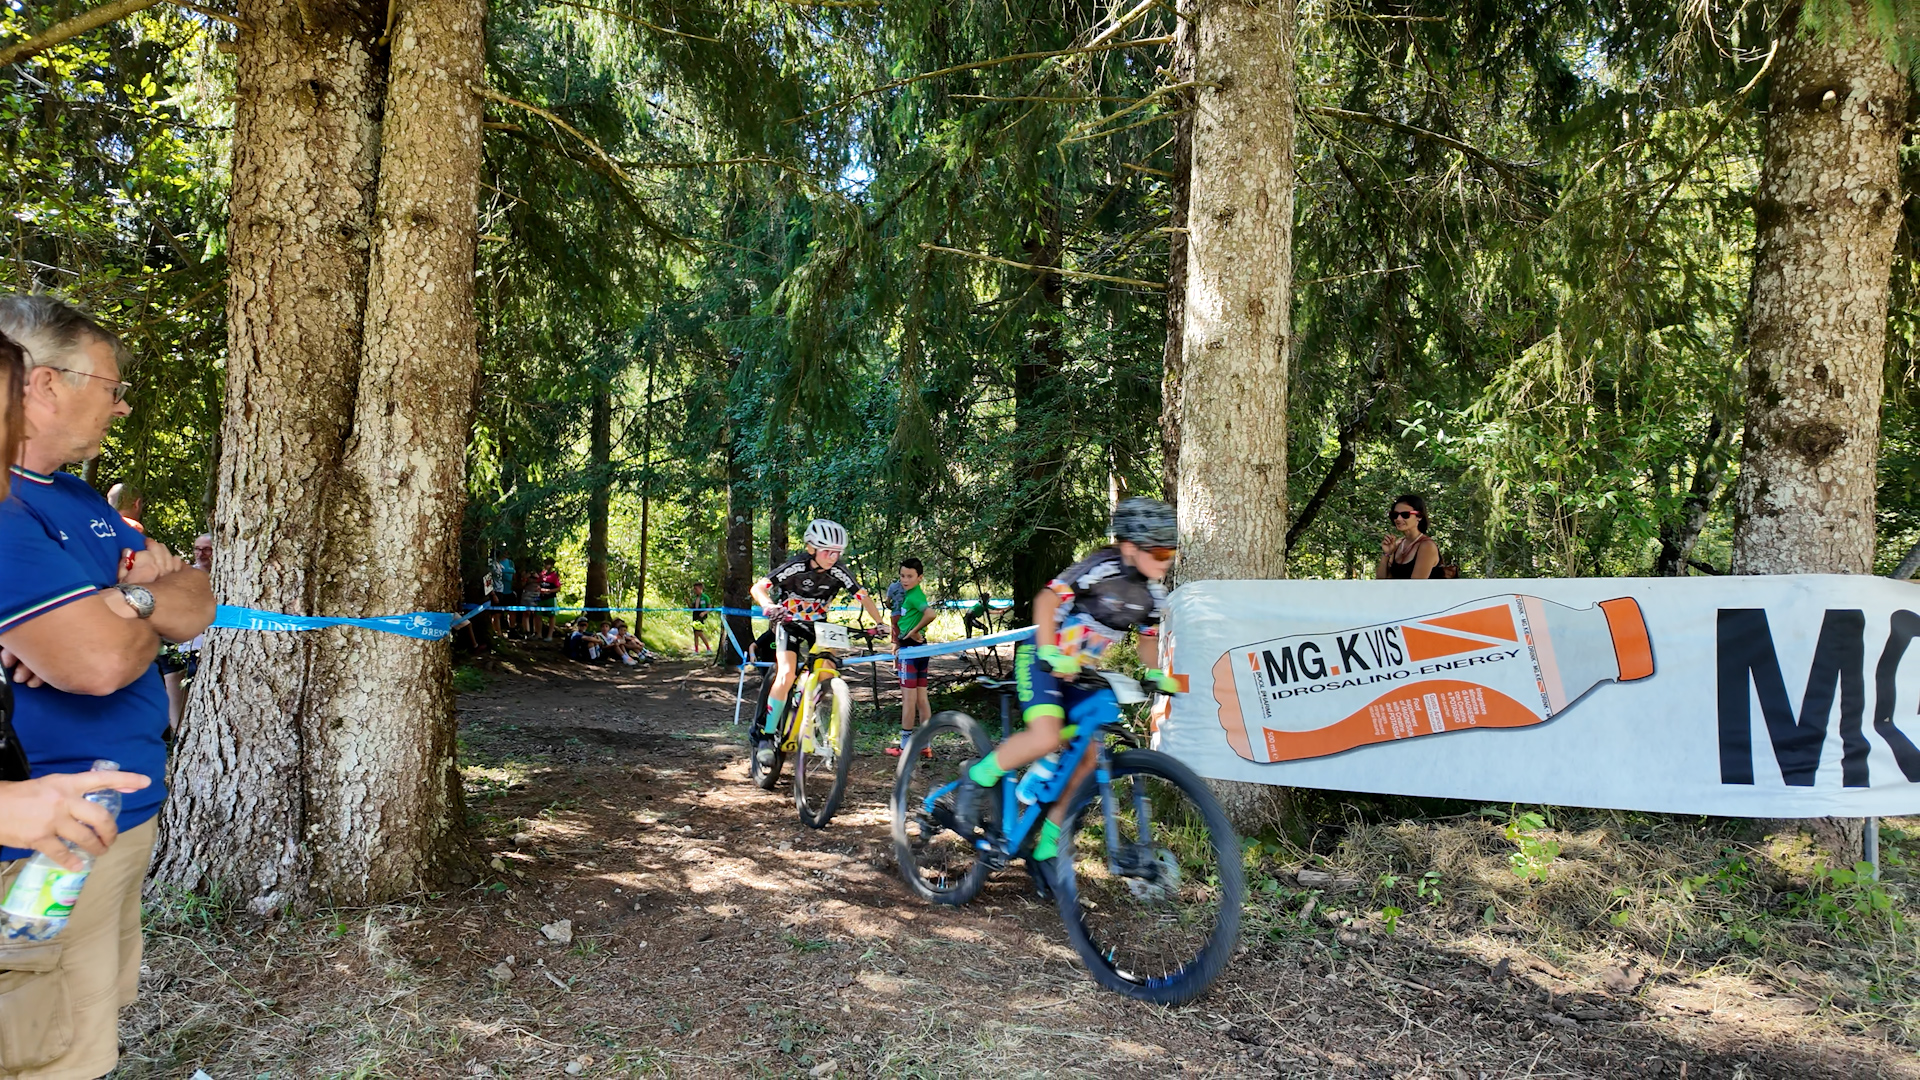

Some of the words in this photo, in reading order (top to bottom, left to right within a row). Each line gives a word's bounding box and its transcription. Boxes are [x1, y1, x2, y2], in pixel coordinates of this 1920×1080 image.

[1271, 648, 1520, 700] IDROSALINO-ENERGY
[1260, 690, 1272, 718] PHARMA
[1405, 699, 1419, 727] supplement
[1412, 698, 1422, 710] Food
[1430, 694, 1439, 710] Gusto
[1448, 696, 1461, 723] POTASSIO
[1457, 701, 1467, 722] Creatina
[1462, 695, 1477, 725] MAGNESIO
[1469, 688, 1480, 715] alimentare
[1475, 687, 1487, 715] Integratore
[1389, 712, 1402, 739] POTASSIU
[1395, 712, 1405, 732] Creatine
[1433, 710, 1443, 730] Arancia
[1267, 731, 1276, 743] 500
[1269, 744, 1278, 752] ml
